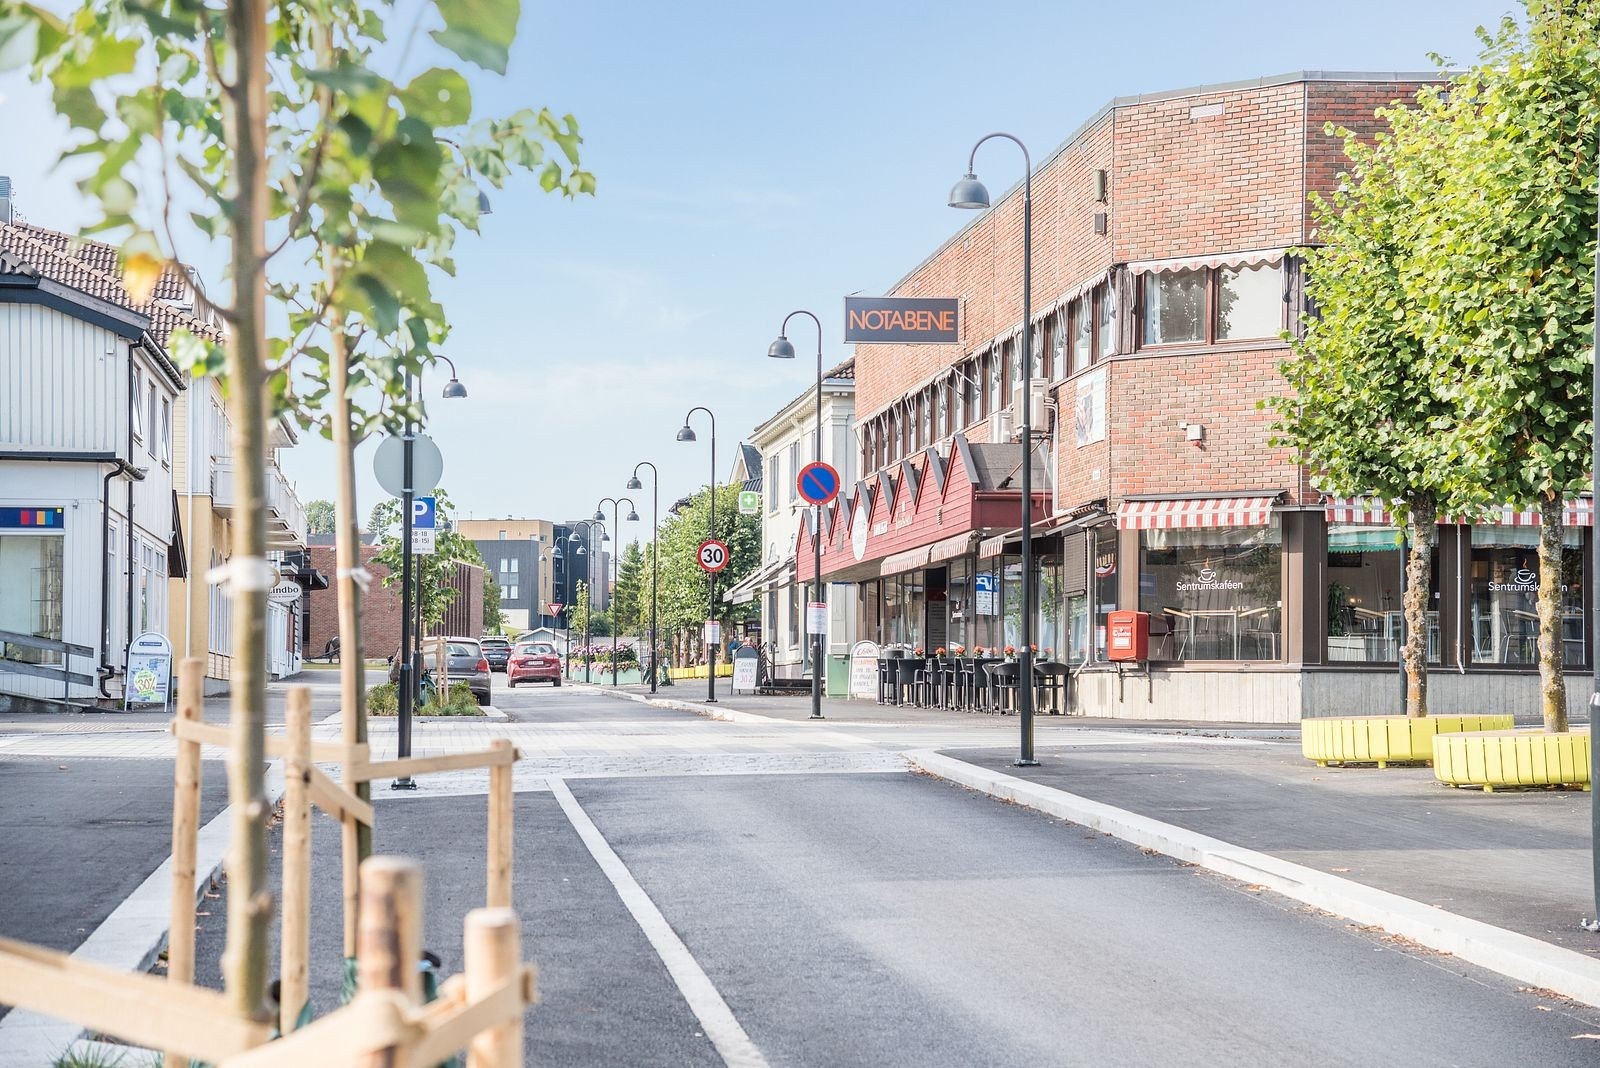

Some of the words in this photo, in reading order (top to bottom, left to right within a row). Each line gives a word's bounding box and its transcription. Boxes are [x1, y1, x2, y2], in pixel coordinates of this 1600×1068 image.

[850, 310, 954, 331] NOTABENE
[412, 500, 428, 524] P
[703, 548, 723, 564] 30
[270, 586, 299, 594] indbo
[1176, 580, 1243, 591] Sentrumskaféen
[1488, 581, 1568, 592] Sentrumskn
[138, 676, 156, 691] 30%
